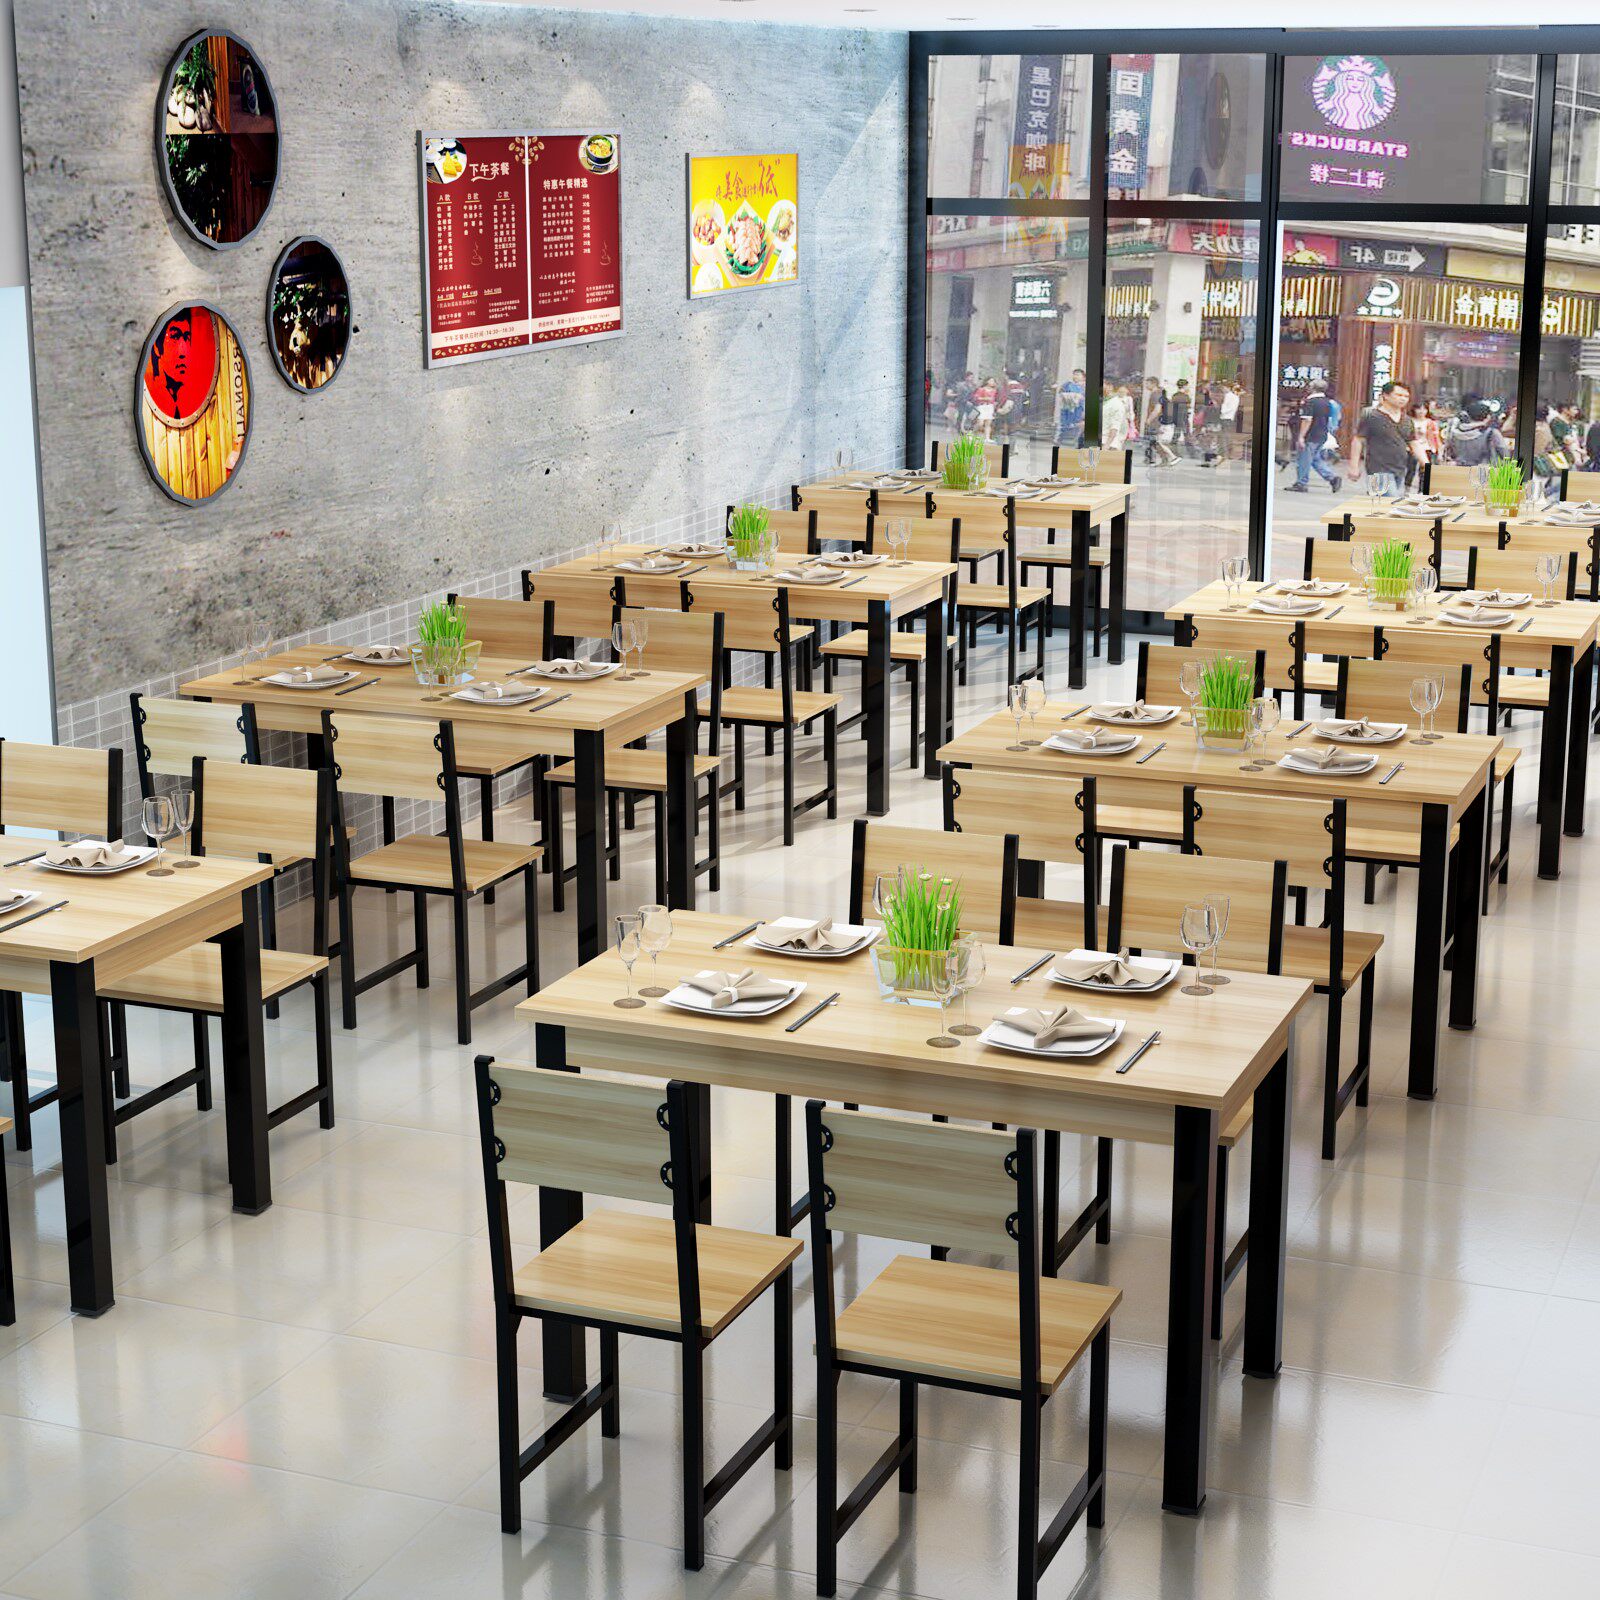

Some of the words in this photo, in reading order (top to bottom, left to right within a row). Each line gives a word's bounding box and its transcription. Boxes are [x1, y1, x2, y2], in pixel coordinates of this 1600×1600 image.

[469, 162, 510, 180] 下午茶餐
[543, 177, 588, 190] 特惠午餐精选
